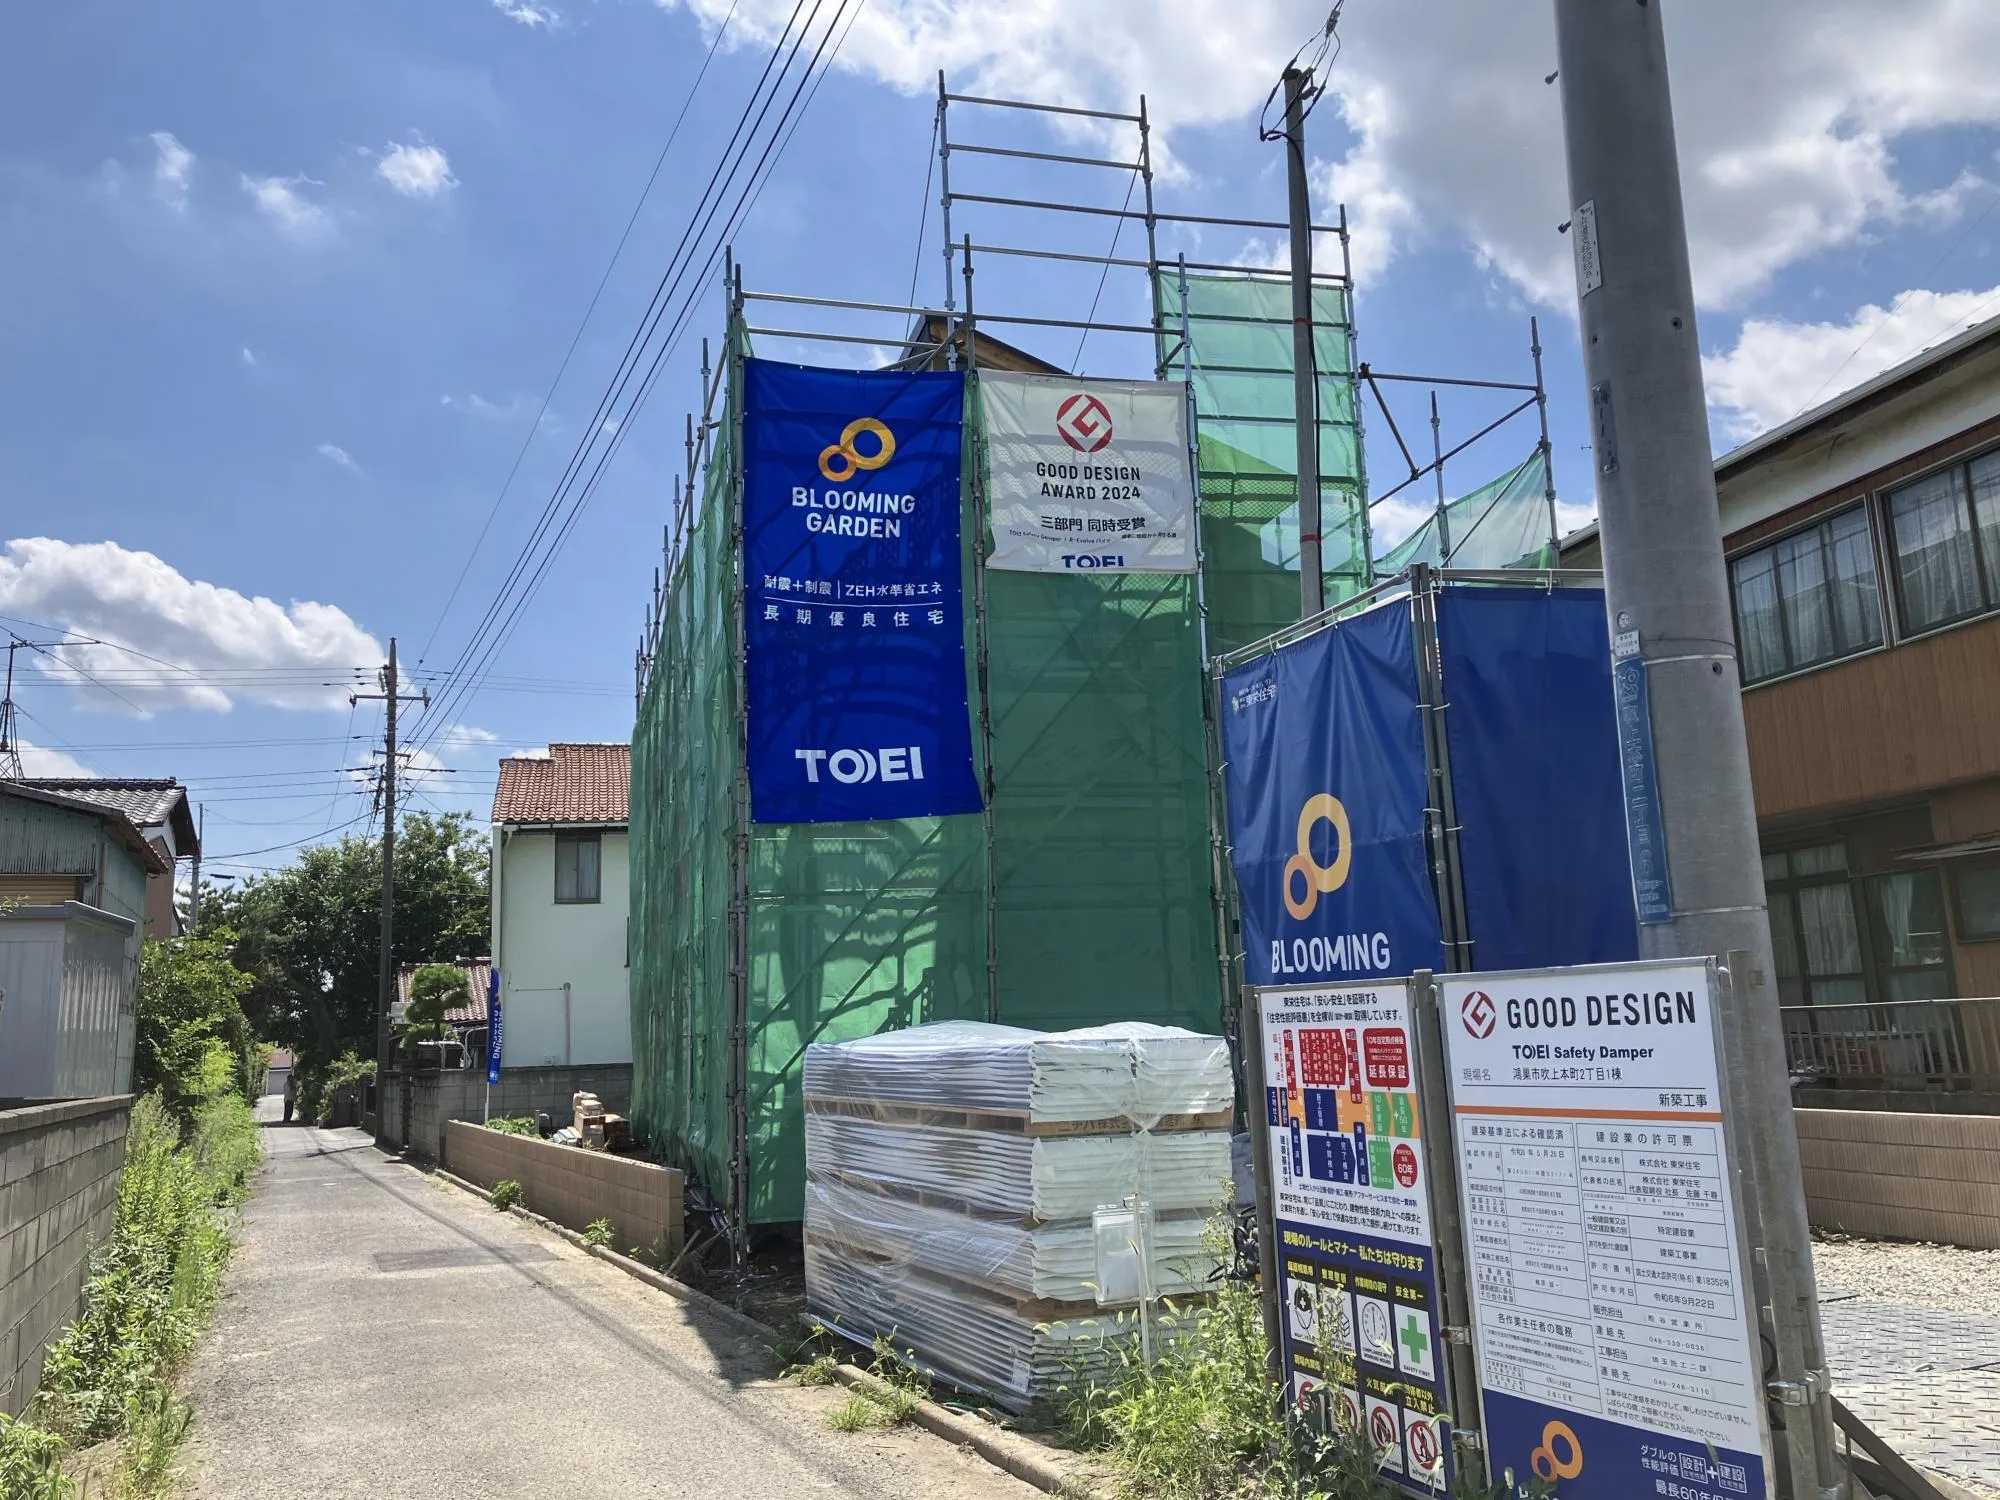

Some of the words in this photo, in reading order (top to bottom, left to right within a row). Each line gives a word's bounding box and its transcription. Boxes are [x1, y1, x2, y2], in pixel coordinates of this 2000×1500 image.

[1036, 462, 1078, 480] GOOD
[1084, 466, 1141, 481] DESIGN
[1041, 482, 1096, 500] AWARD
[1102, 485, 1141, 500] 2024
[791, 486, 915, 515] BLOOMING
[806, 512, 901, 538] GARDEN
[1041, 516, 1082, 531] 三部門
[1087, 517, 1145, 532] 同時受賞
[845, 583, 943, 598] ZEH水準省エネ
[764, 605, 944, 627] 長期優良住宅
[795, 746, 924, 784] TOEI
[1271, 932, 1390, 974] BLOOMING
[1507, 994, 1576, 1029] GOOD
[1587, 991, 1696, 1026] DESIGN
[1512, 1044, 1550, 1060] TOEI
[1554, 1046, 1595, 1062] Safety
[1599, 1046, 1654, 1062] Damper
[1368, 1064, 1407, 1080] 延長保証
[1463, 1068, 1492, 1081] 現場名
[1512, 1067, 1623, 1081] 鴻巣市吹上本町2丁目1棟
[1658, 1093, 1708, 1108] 新築工事
[1471, 1125, 1564, 1141] 建築基準法による確認済
[1596, 1131, 1694, 1147] 建設業の許可票
[1397, 1164, 1413, 1174] 60年
[1639, 1159, 1668, 1168] 株式会社
[1670, 1160, 1701, 1171] 東栄住宅
[1582, 1176, 1623, 1187] 代表者の氏名
[1642, 1176, 1670, 1186] 株式会社
[1672, 1178, 1701, 1188] 東栄住宅
[1629, 1185, 1662, 1196] 代表取締役
[1665, 1187, 1679, 1197] 社長
[1686, 1188, 1700, 1198] 佐藤
[1657, 1225, 1695, 1238] 特定建設業
[1283, 1230, 1357, 1254] 現場のルールとマナー
[1359, 1248, 1425, 1272] 私たちは守ります
[1659, 1248, 1697, 1260] 建築工事業
[1395, 1286, 1424, 1300] 安全第一
[1593, 1283, 1634, 1297] 許可年月日
[1654, 1292, 1715, 1309] 令和6年9月22日
[1593, 1304, 1623, 1318] 販売担当
[1497, 1313, 1573, 1337] 各作業主任者の職務
[1595, 1325, 1626, 1340] 連絡先
[1598, 1346, 1628, 1360] 工事担当
[1600, 1365, 1631, 1381] 連絡先
[1406, 1397, 1435, 1414] 立入禁止
[1640, 1444, 1677, 1462] ダブルの
[1682, 1457, 1704, 1473] 設計
[1720, 1465, 1745, 1482] 建設
[1655, 1478, 1734, 1500] 最長60年
